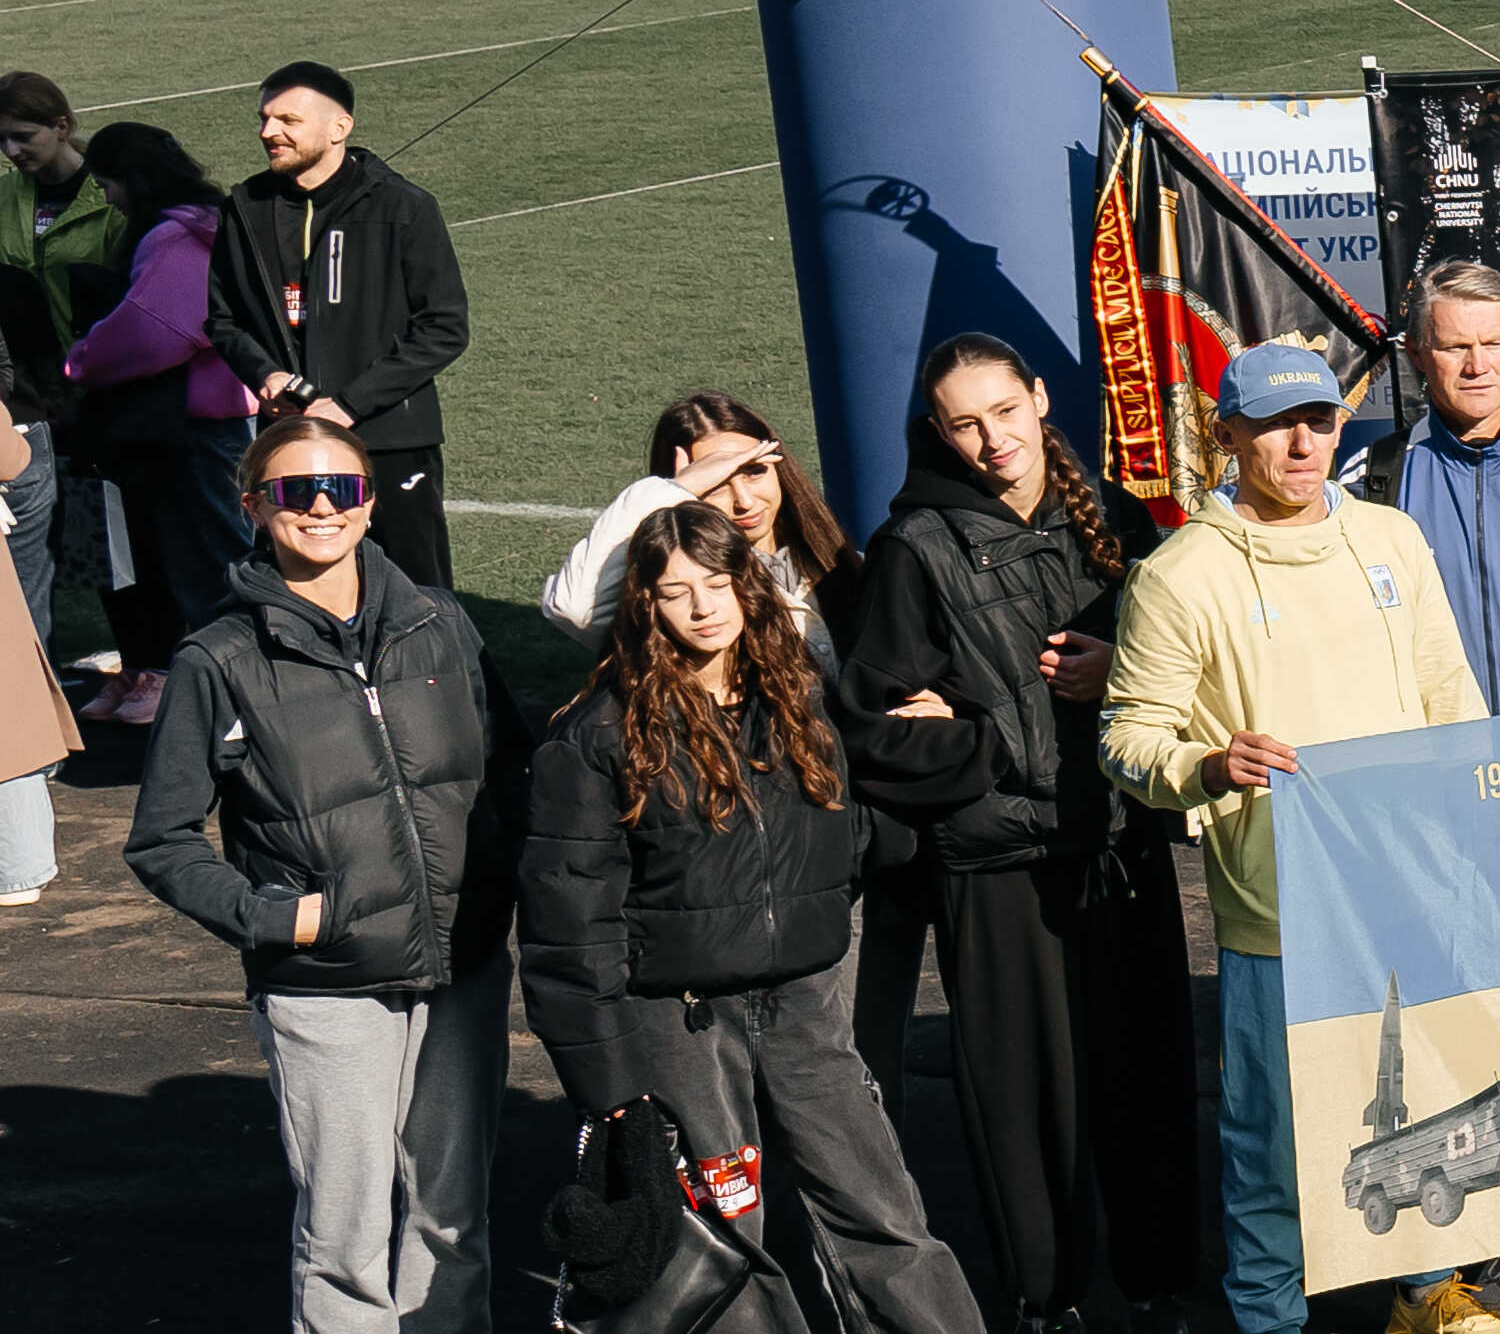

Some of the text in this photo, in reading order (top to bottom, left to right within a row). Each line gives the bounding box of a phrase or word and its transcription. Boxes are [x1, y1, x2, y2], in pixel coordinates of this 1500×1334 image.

[1435, 173, 1479, 188] CHNU
[1438, 210, 1480, 219] NATIONAL
[1268, 371, 1323, 387] UKRAINE
